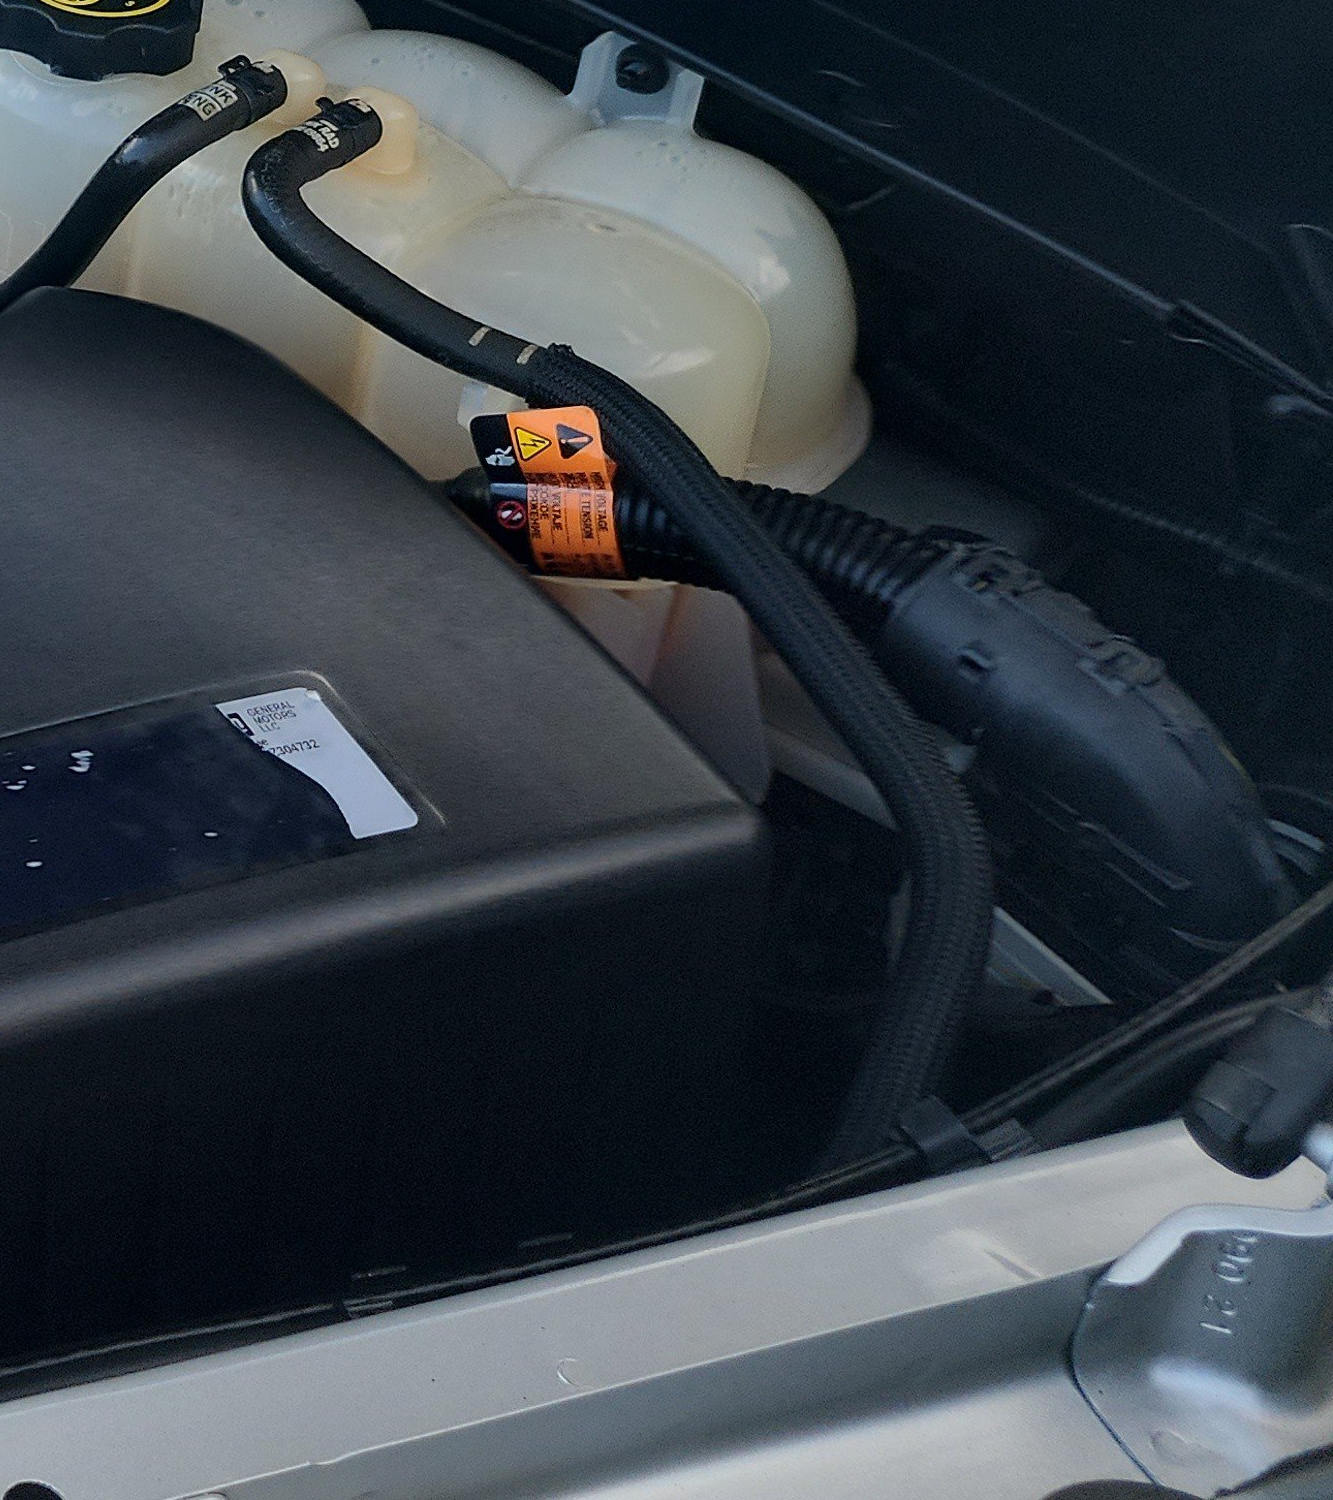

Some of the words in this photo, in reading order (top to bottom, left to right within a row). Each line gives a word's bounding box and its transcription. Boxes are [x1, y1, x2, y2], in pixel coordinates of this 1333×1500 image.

[552, 492, 563, 531] VOLTAJE
[582, 501, 593, 539] TENSION
[596, 492, 609, 532] VOLTAGE
[246, 701, 295, 716] GENERAL
[252, 709, 297, 724] MOTORS
[258, 722, 281, 732] LLC
[262, 739, 320, 756] 7304732
